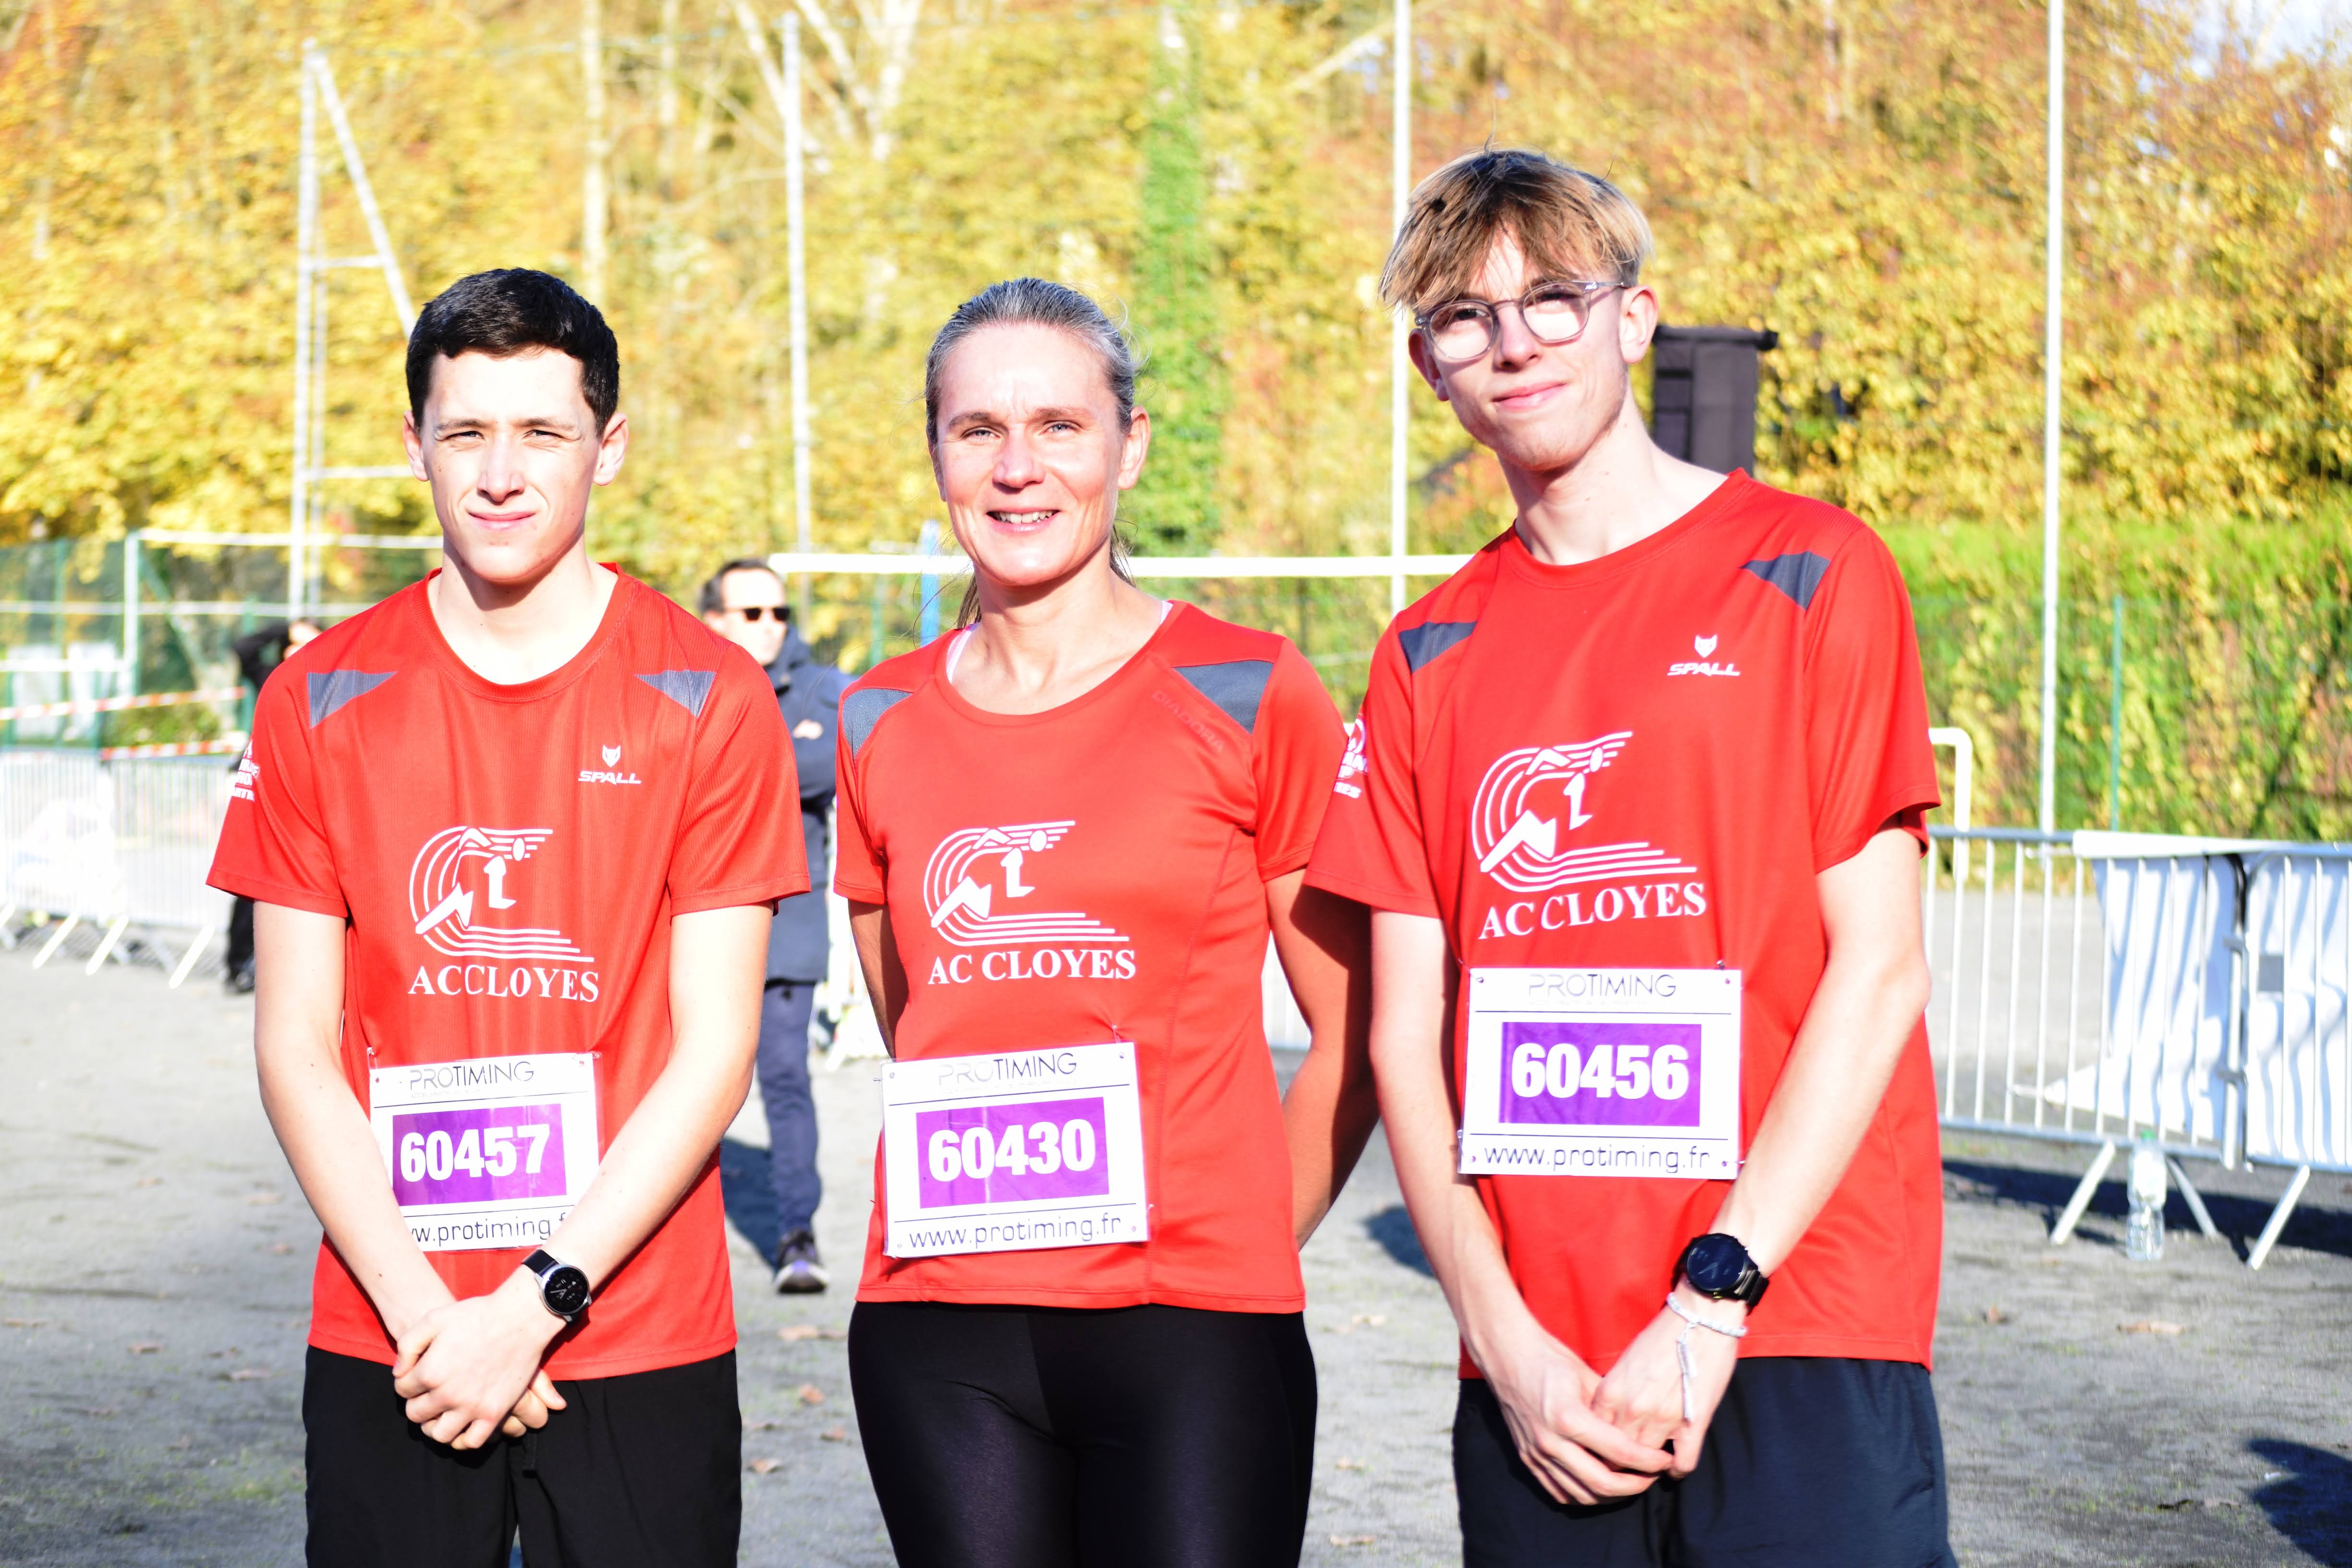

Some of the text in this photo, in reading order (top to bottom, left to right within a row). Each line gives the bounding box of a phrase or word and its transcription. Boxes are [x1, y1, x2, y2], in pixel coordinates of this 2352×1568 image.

[1667, 662, 1741, 677] SPALL
[1152, 690, 1224, 754] DIADORA
[578, 770, 642, 786] SPALL
[1478, 882, 1707, 940] AC CLOYES
[928, 949, 1136, 985] AC CLOYES
[1529, 973, 1676, 997] PROTIMING
[410, 1061, 534, 1090] PROTIMING
[938, 1052, 1077, 1086] PROTIMING
[1511, 1043, 1689, 1100] 60456
[400, 1123, 551, 1182] 60457
[928, 1118, 1096, 1182] 60430
[1484, 1144, 1710, 1173] www.protiming.fr
[909, 1212, 1121, 1248] www.protiming.fr
